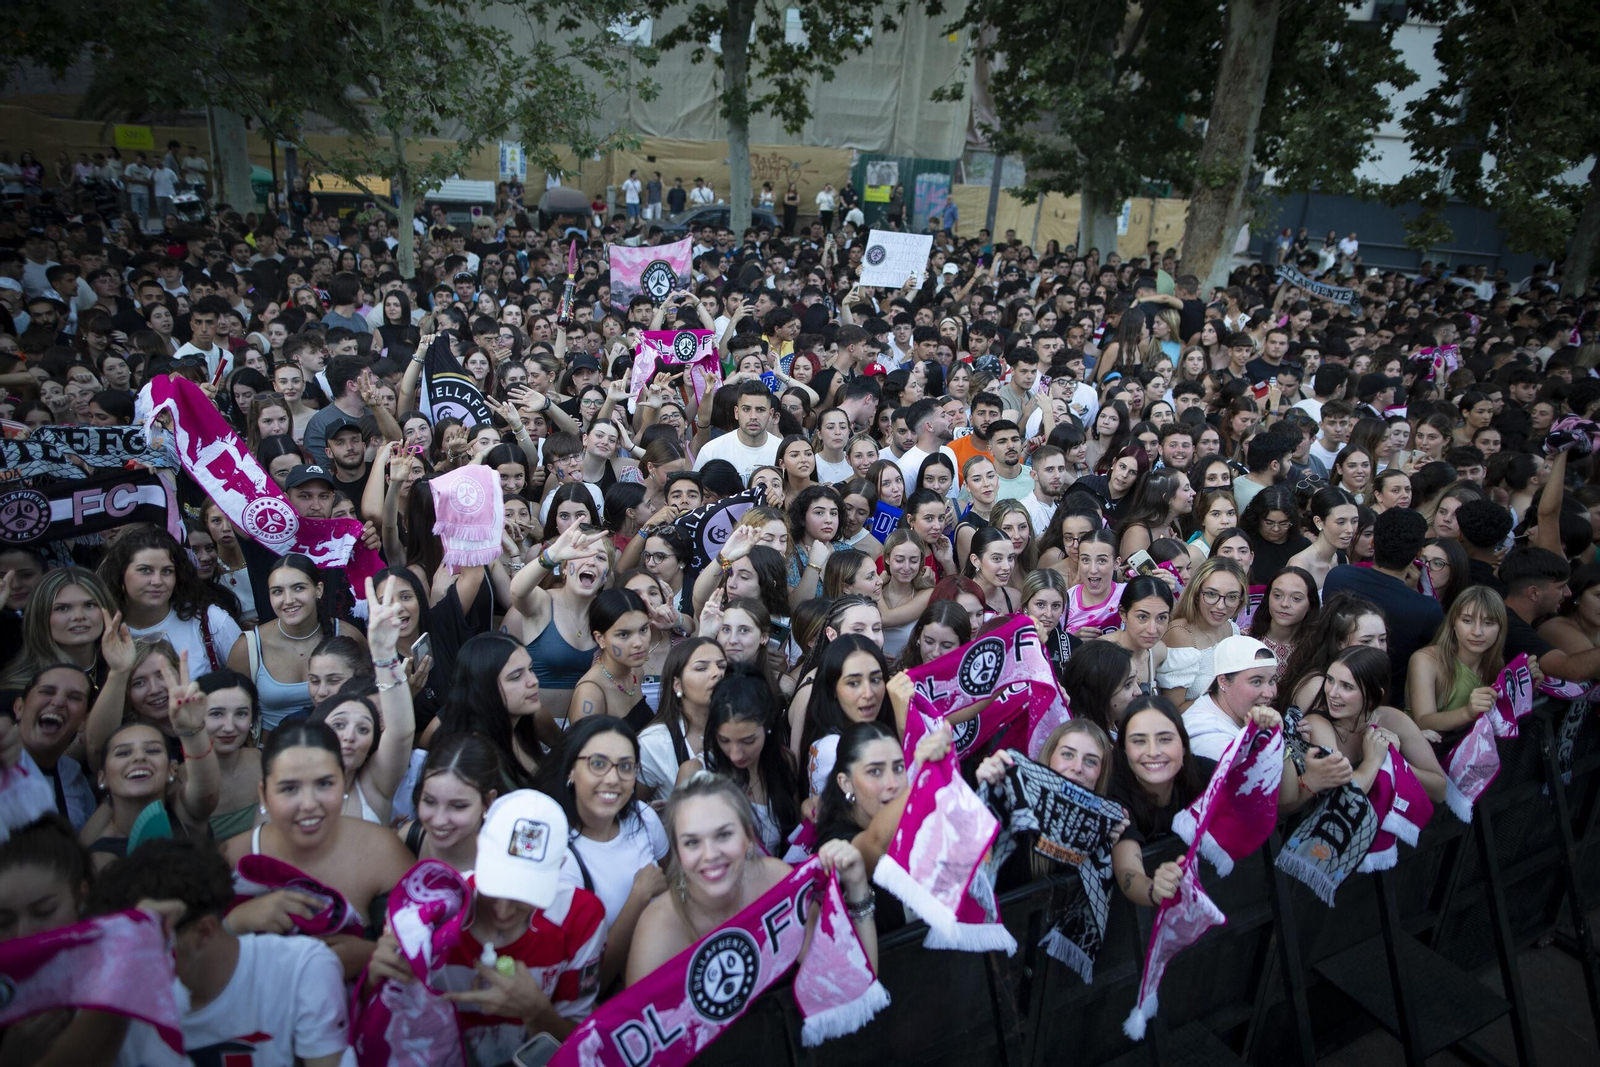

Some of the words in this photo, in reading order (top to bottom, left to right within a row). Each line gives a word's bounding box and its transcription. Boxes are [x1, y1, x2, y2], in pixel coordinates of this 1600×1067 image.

[72, 483, 139, 526] FC
[692, 936, 751, 991] DELLAFUENTE
[610, 1003, 687, 1067] DL
